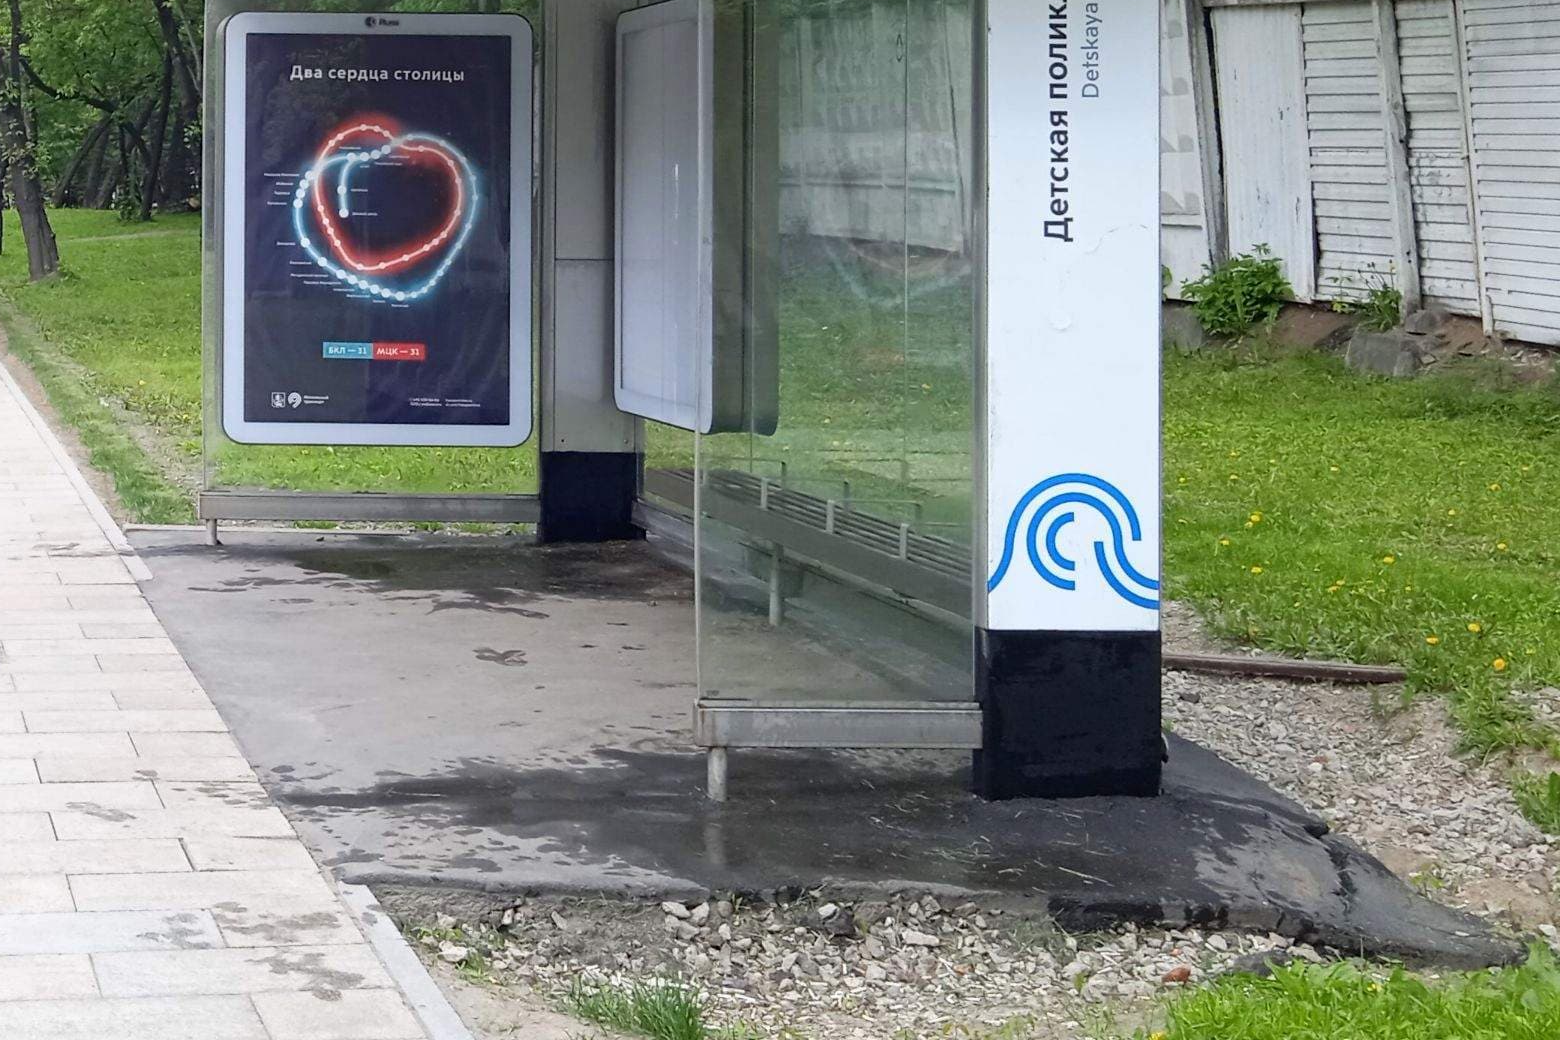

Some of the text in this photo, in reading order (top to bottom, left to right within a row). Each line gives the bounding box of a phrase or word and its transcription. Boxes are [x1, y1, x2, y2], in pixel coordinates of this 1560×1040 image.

[1080, 2, 1102, 98] Detskaya
[290, 65, 465, 82] Два сердца столицы
[1043, 110, 1073, 243] Детская
[328, 346, 346, 355] БКЛ
[358, 347, 367, 355] 31
[376, 347, 399, 356] МЦК
[410, 348, 420, 356] 31
